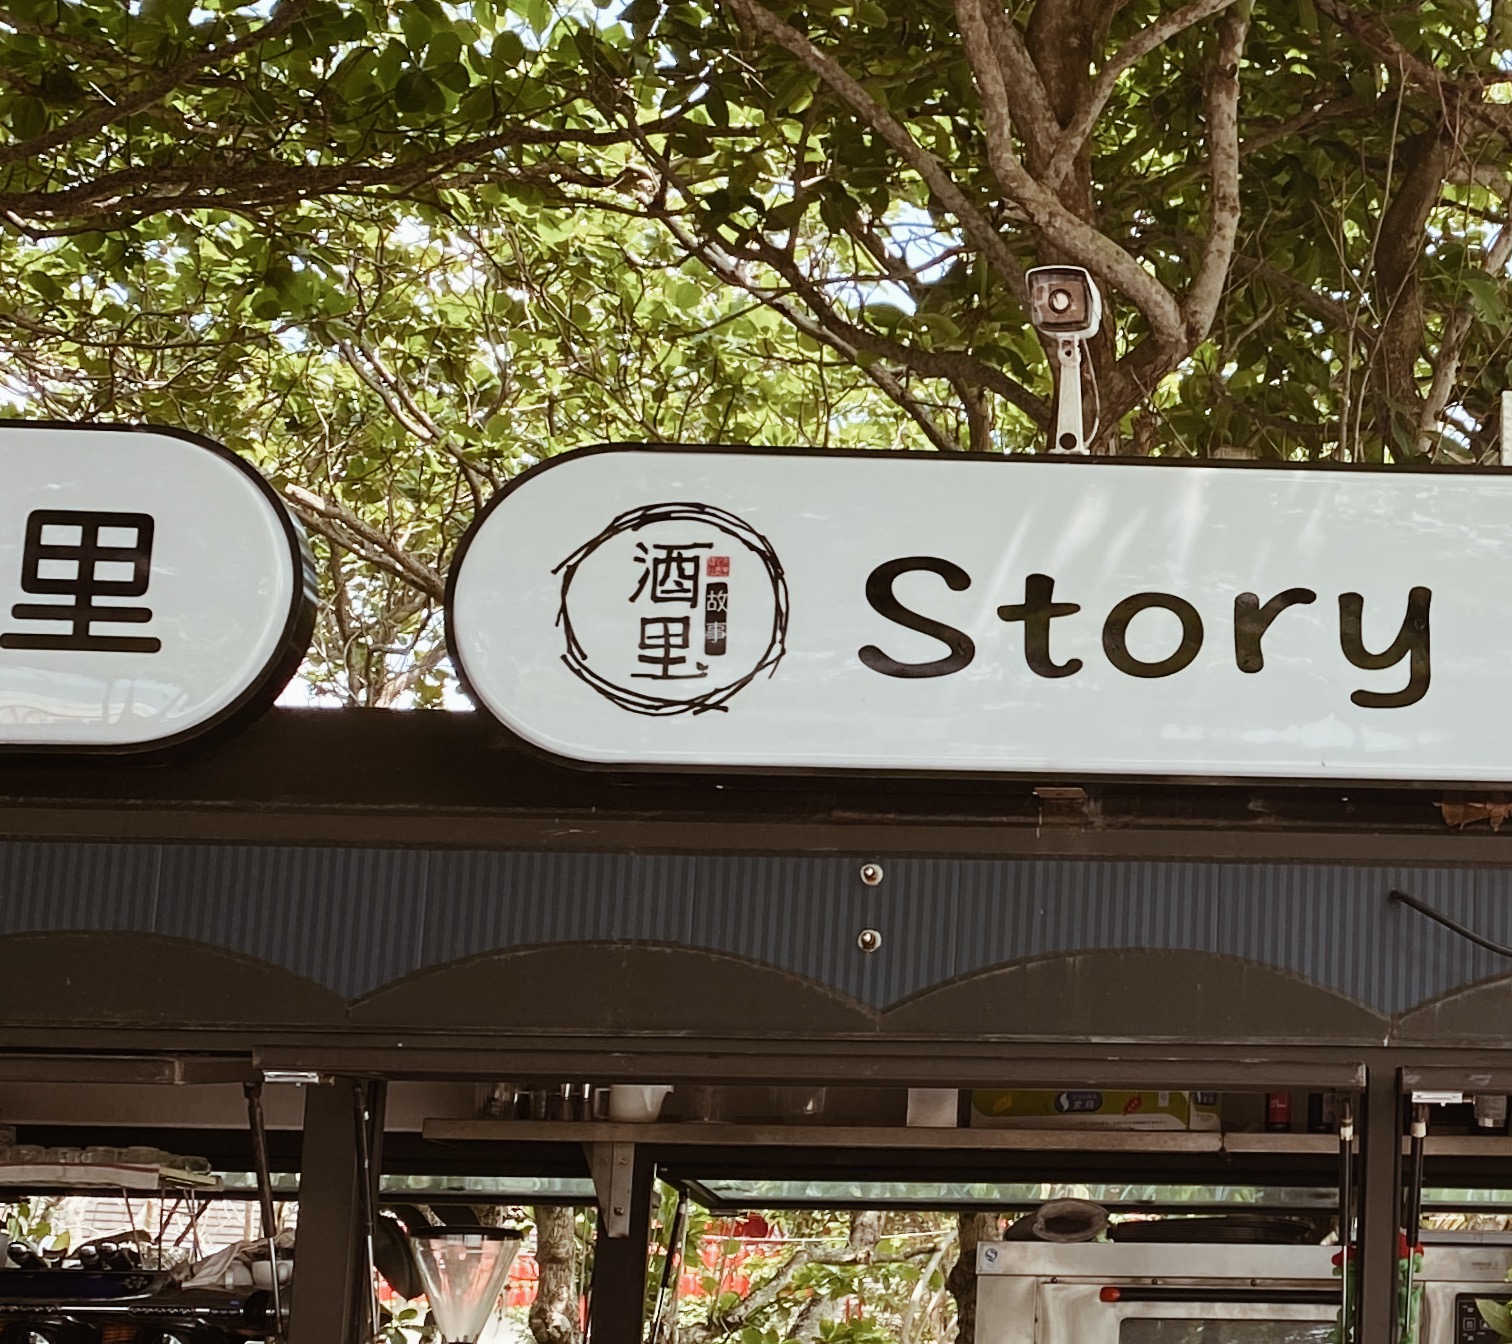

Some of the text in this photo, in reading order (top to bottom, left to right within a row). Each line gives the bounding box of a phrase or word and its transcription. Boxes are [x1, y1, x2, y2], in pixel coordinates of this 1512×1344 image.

[0, 510, 161, 653] 里
[629, 542, 713, 680] 酒里
[705, 589, 727, 644] 故事
[858, 556, 1432, 709] Story
